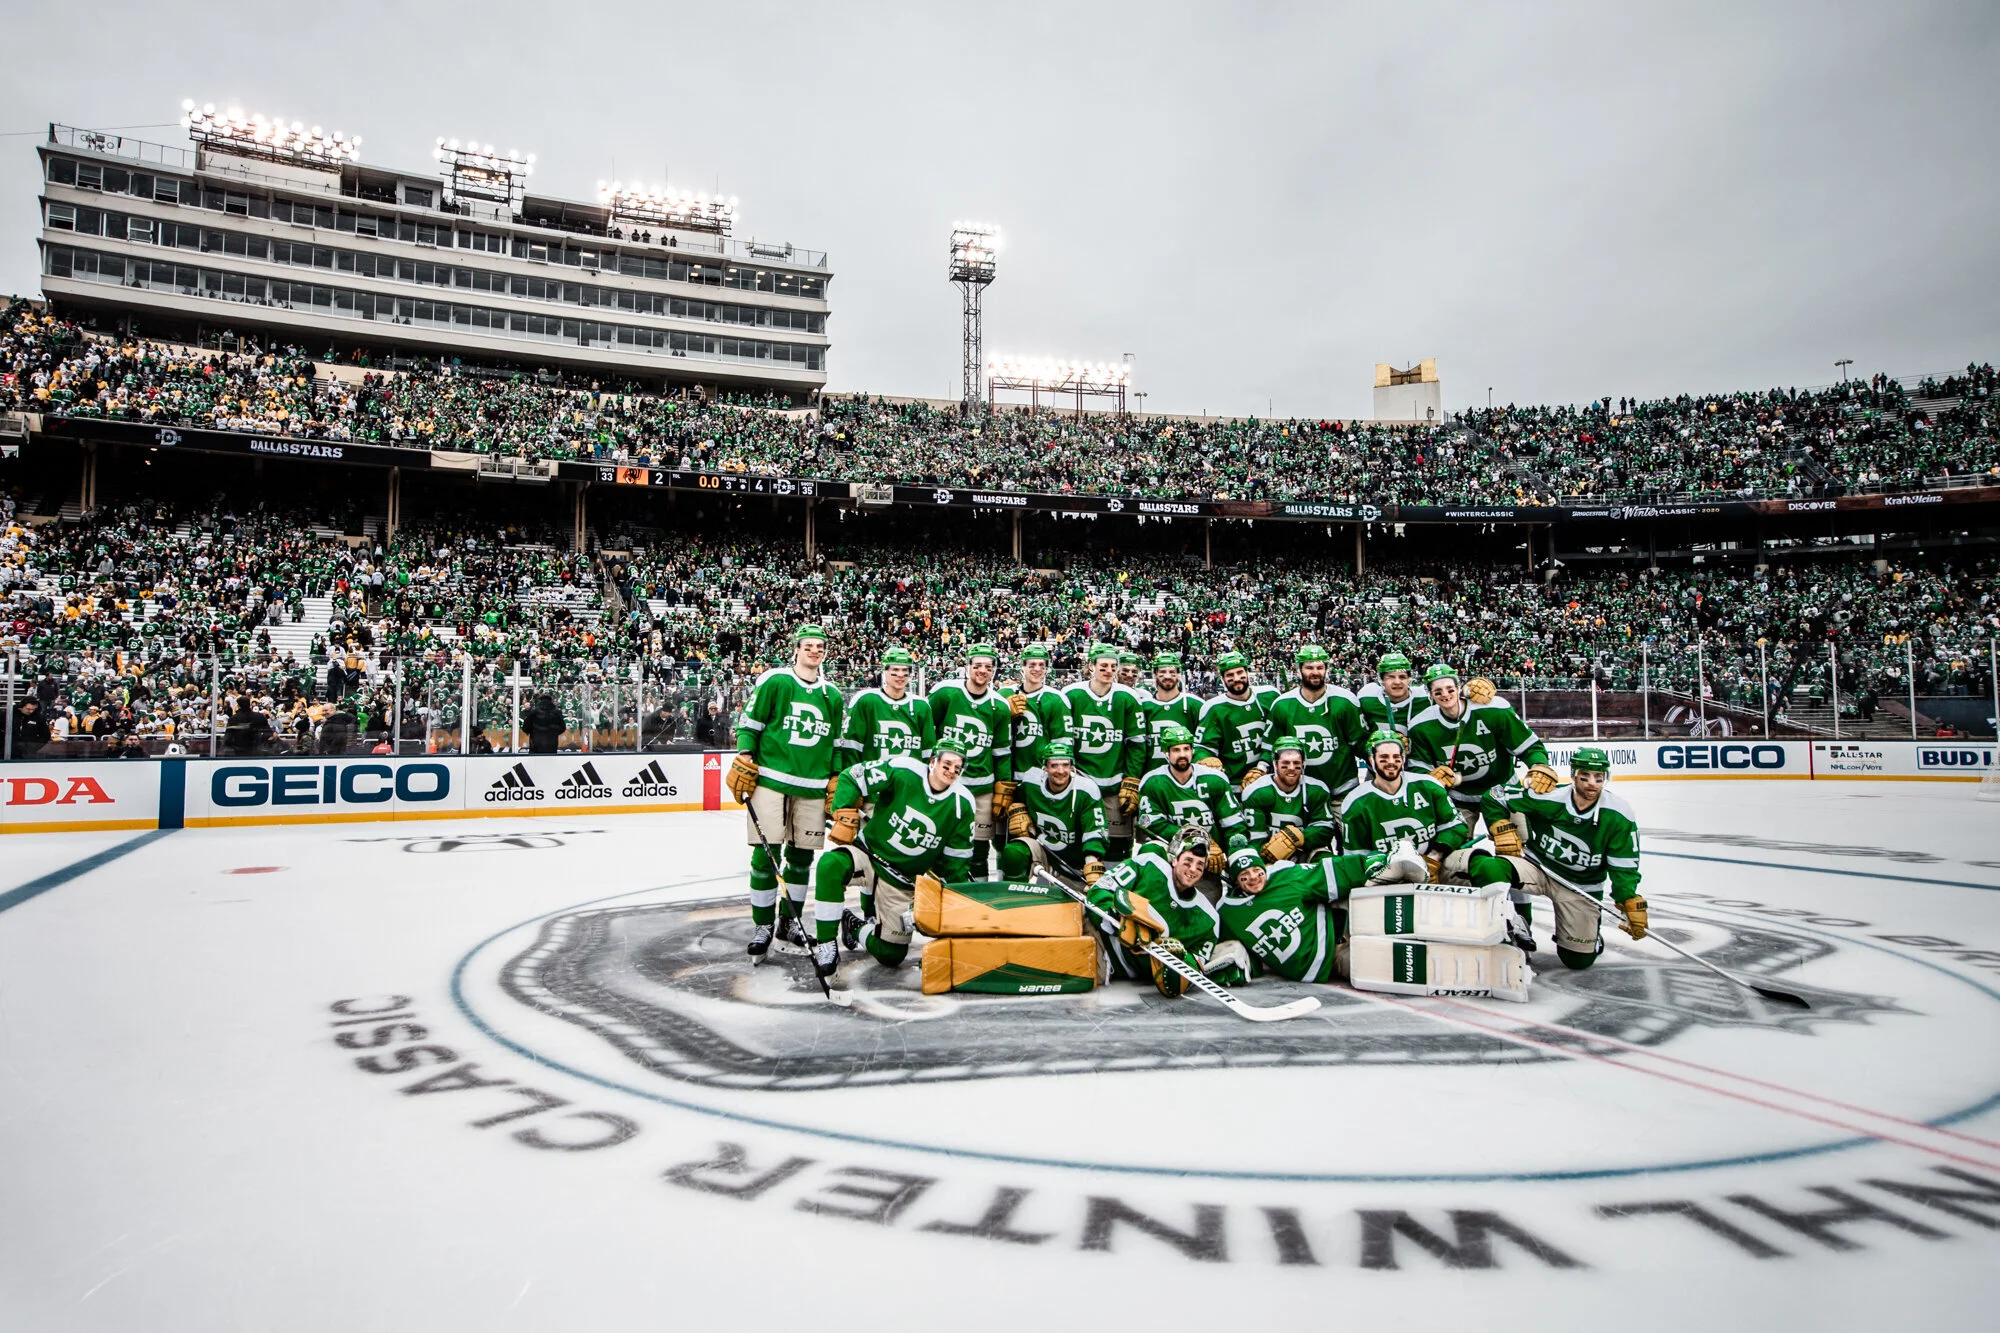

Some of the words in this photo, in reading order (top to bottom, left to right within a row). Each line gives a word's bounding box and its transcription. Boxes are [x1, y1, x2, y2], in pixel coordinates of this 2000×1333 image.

[289, 443, 343, 458] STARS
[601, 473, 613, 482] 33
[655, 473, 664, 484] 2
[699, 475, 720, 488] 0.0
[726, 482, 732, 490] 3
[755, 480, 764, 491] 4
[802, 487, 813, 495] 35
[1313, 506, 1353, 517] STARS
[1476, 720, 1491, 735] A
[1611, 749, 1637, 765] VODKA
[1657, 745, 1786, 769] GEICO
[1922, 751, 1979, 766] BUD
[211, 763, 450, 807] GEICO
[555, 784, 613, 800] adidas
[622, 783, 678, 799] adidas
[1197, 783, 1210, 798] C
[484, 786, 545, 802] adidas
[1414, 792, 1430, 810] A
[1093, 808, 1105, 826] 5
[1415, 884, 1478, 895] LEGACY
[1406, 945, 1414, 983] VAUGHN
[328, 993, 642, 1151] CLASSIC
[662, 1141, 1590, 1271] WINTER
[1594, 1164, 2000, 1260] NHL
